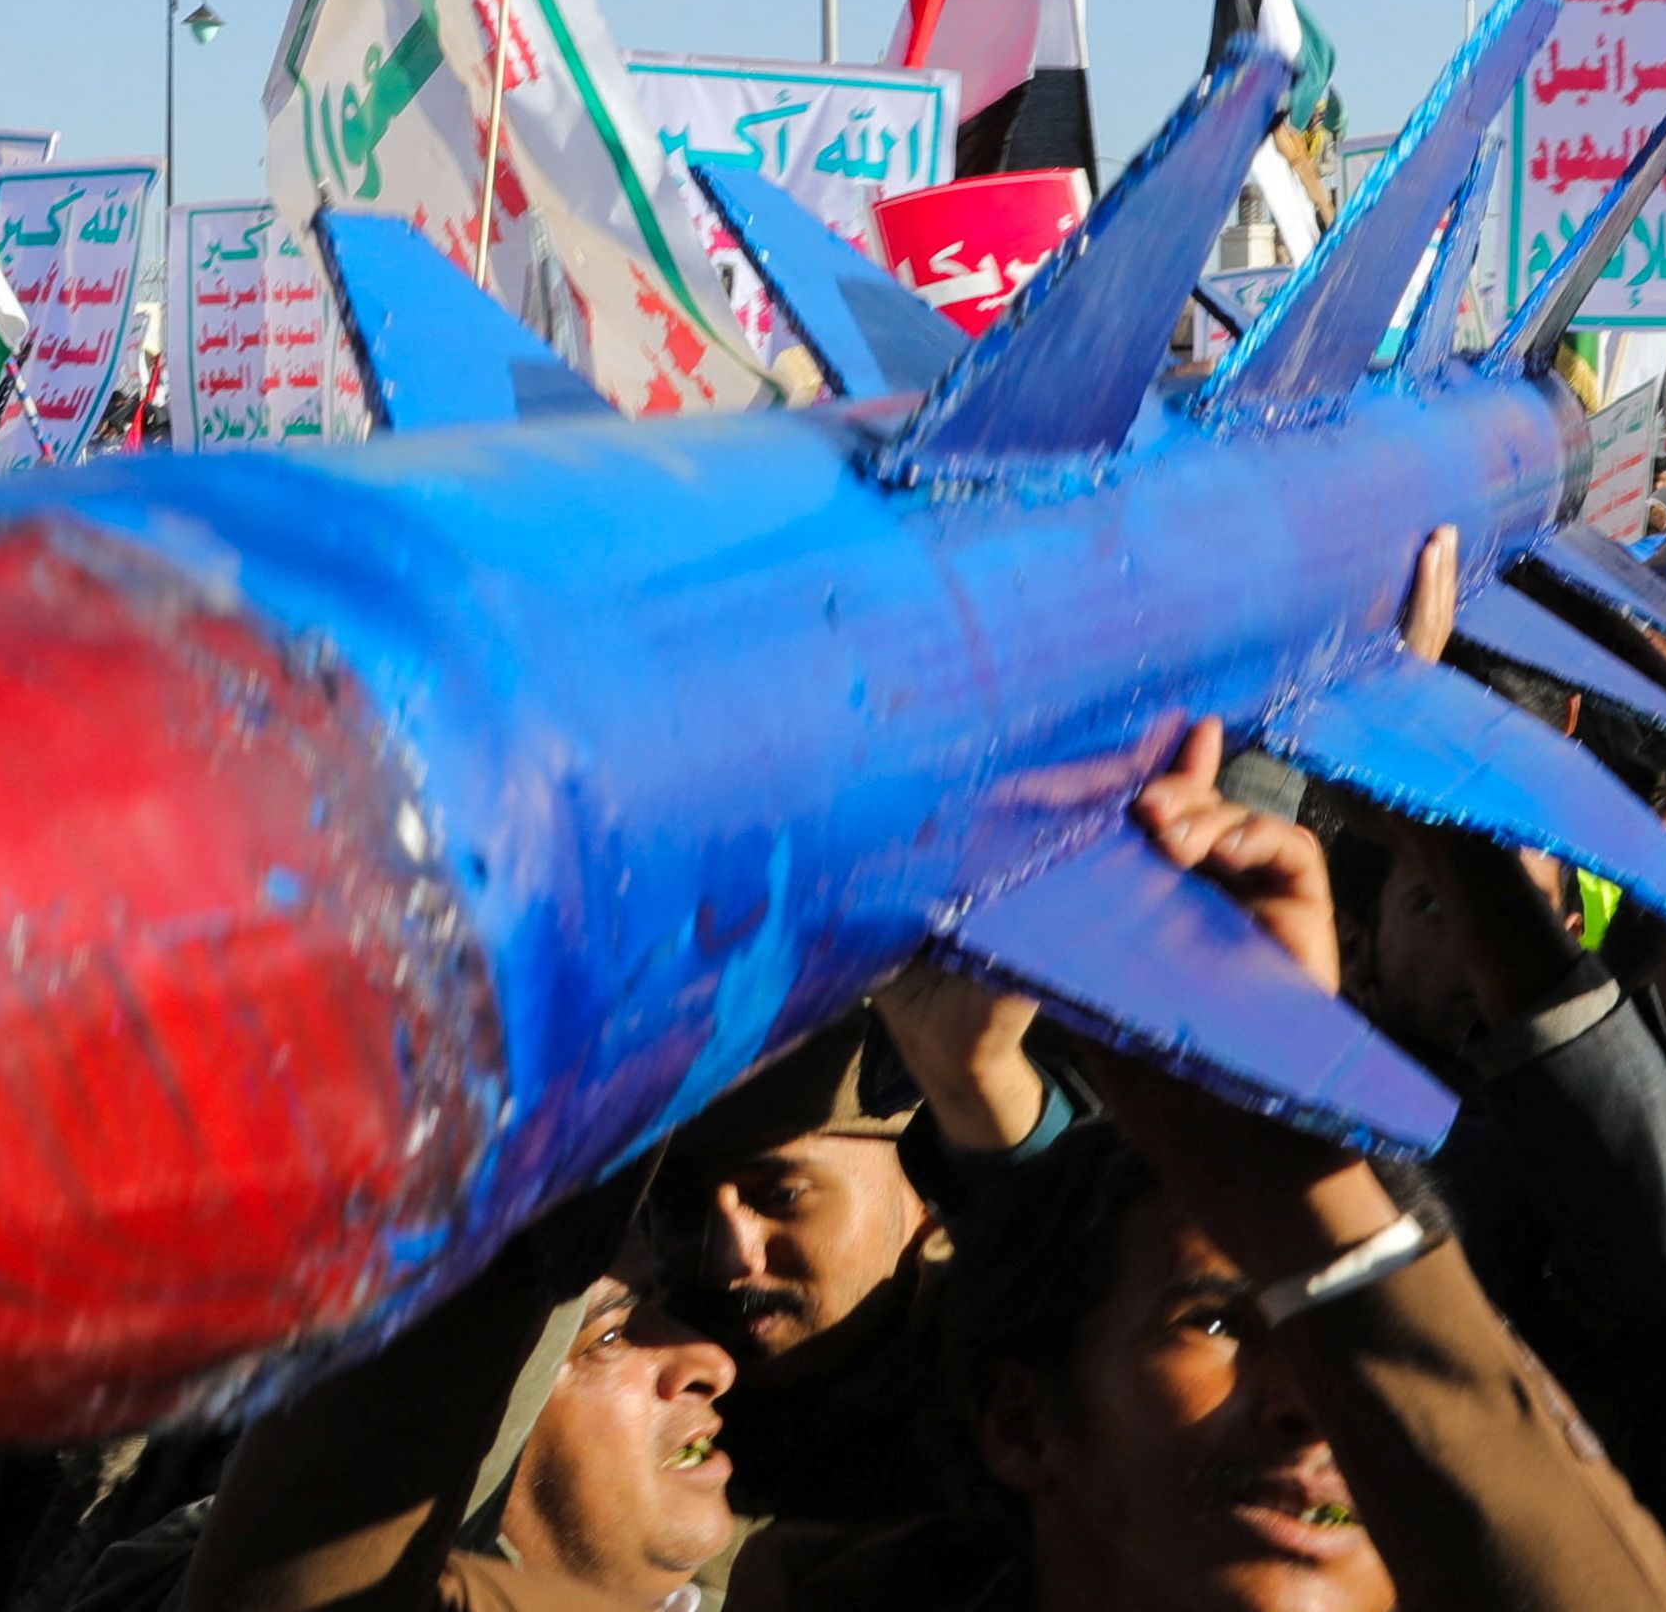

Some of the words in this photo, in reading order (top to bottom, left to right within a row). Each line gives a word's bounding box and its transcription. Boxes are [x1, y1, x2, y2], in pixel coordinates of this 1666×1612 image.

[815, 105, 920, 183] الله
[79, 188, 140, 244] الله
[198, 212, 275, 276] أكبر
[58, 267, 129, 314] الموت
[36, 328, 114, 371] الموت
